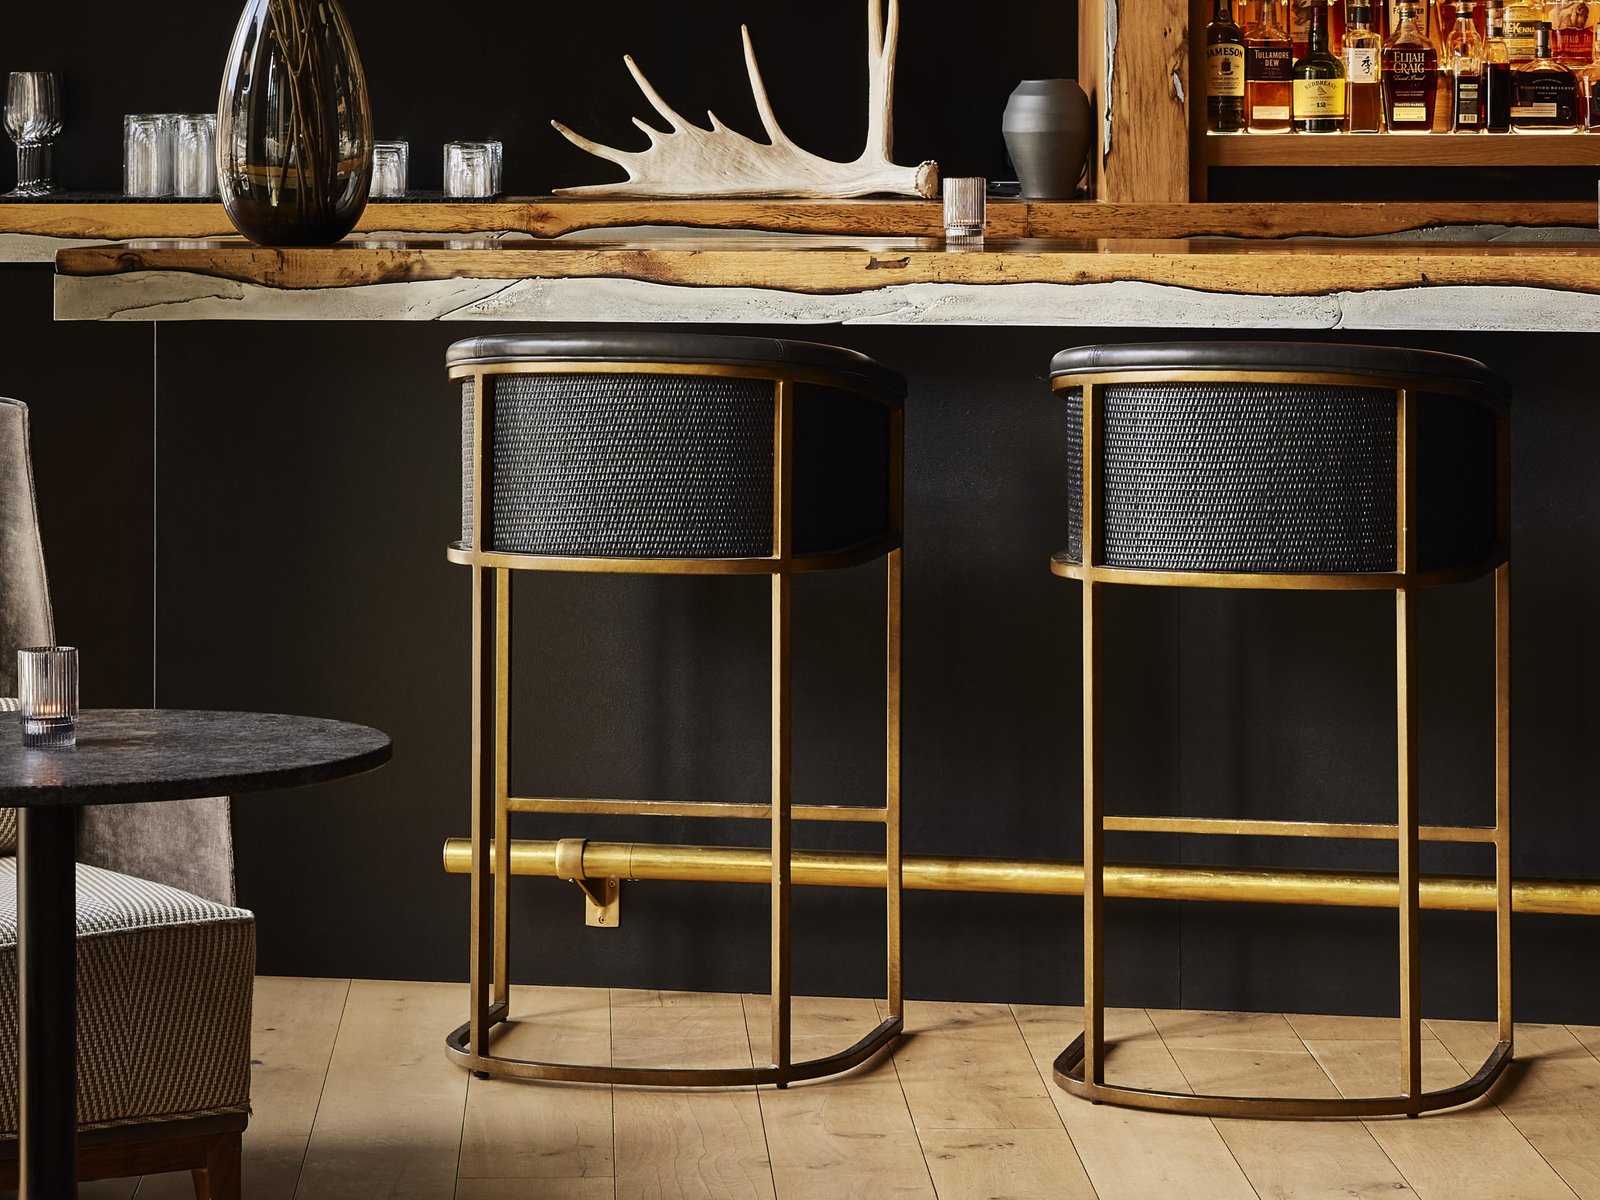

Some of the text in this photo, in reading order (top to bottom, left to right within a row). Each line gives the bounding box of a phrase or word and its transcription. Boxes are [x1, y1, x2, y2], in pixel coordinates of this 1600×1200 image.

[1206, 47, 1243, 58] JAMESON
[1255, 49, 1290, 59] TULLAMORE
[1393, 51, 1425, 63] ELIJAH
[1264, 59, 1280, 67] DEW
[1393, 62, 1425, 75] CRAIG
[1304, 80, 1337, 90] REDBREAST
